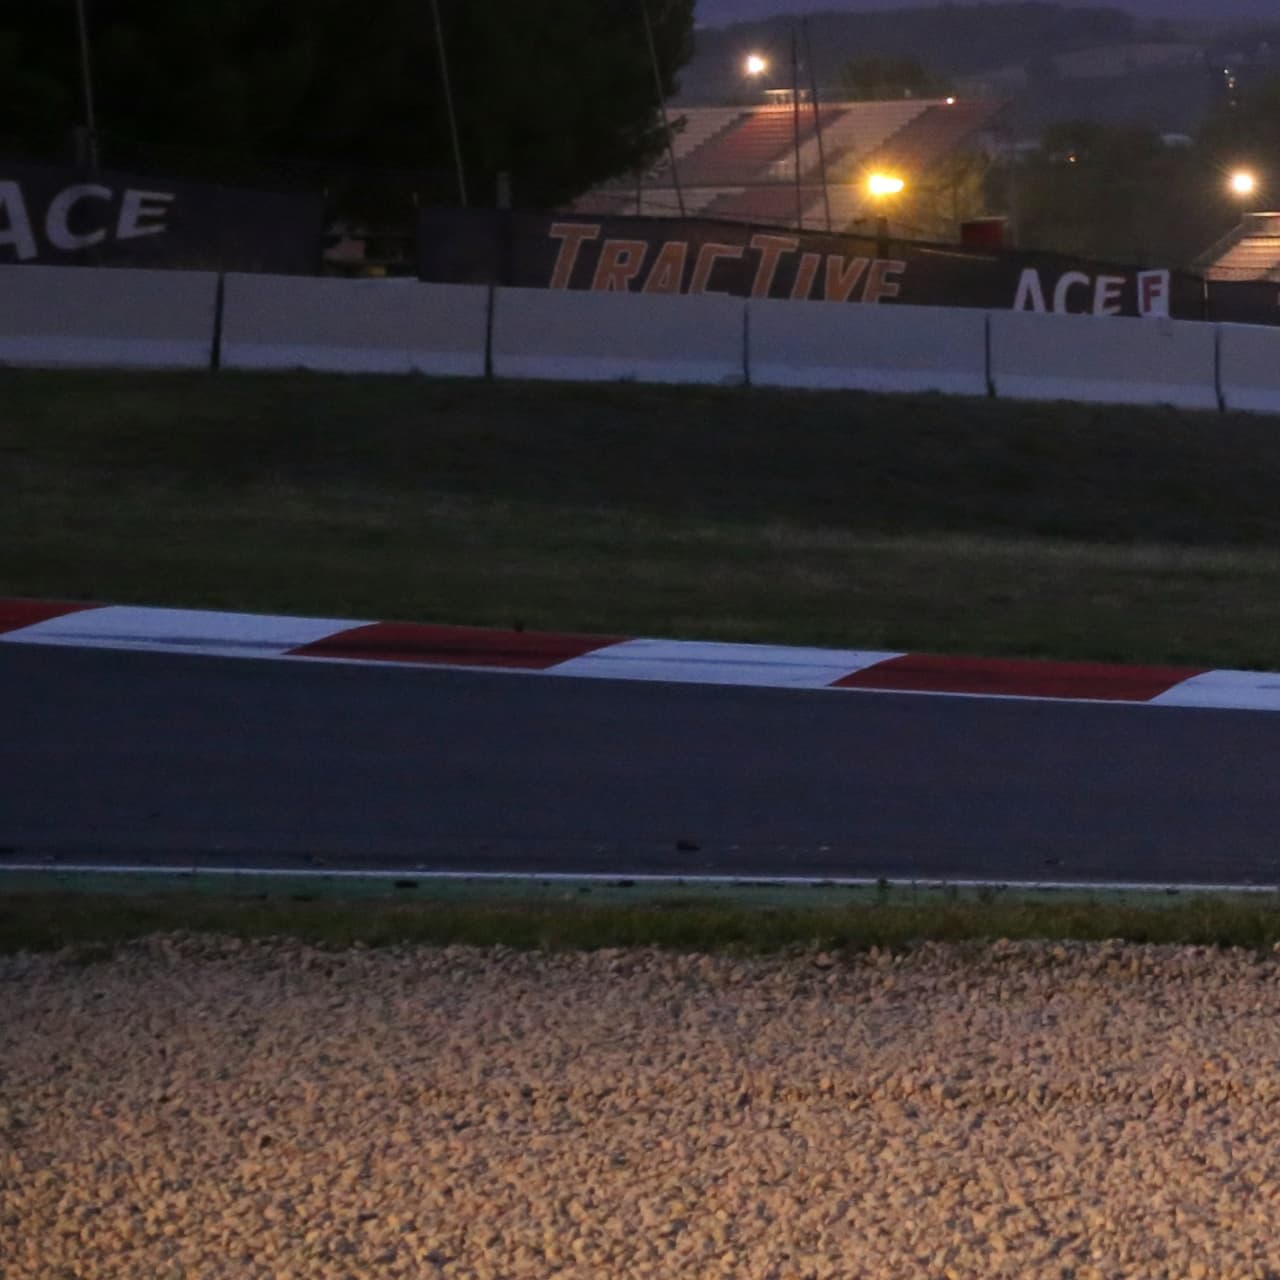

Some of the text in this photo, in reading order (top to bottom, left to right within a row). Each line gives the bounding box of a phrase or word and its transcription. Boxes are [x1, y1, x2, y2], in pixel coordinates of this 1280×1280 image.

[0, 179, 175, 260] ACE
[549, 222, 906, 303] TRACTIVE
[1013, 268, 1126, 315] ACE
